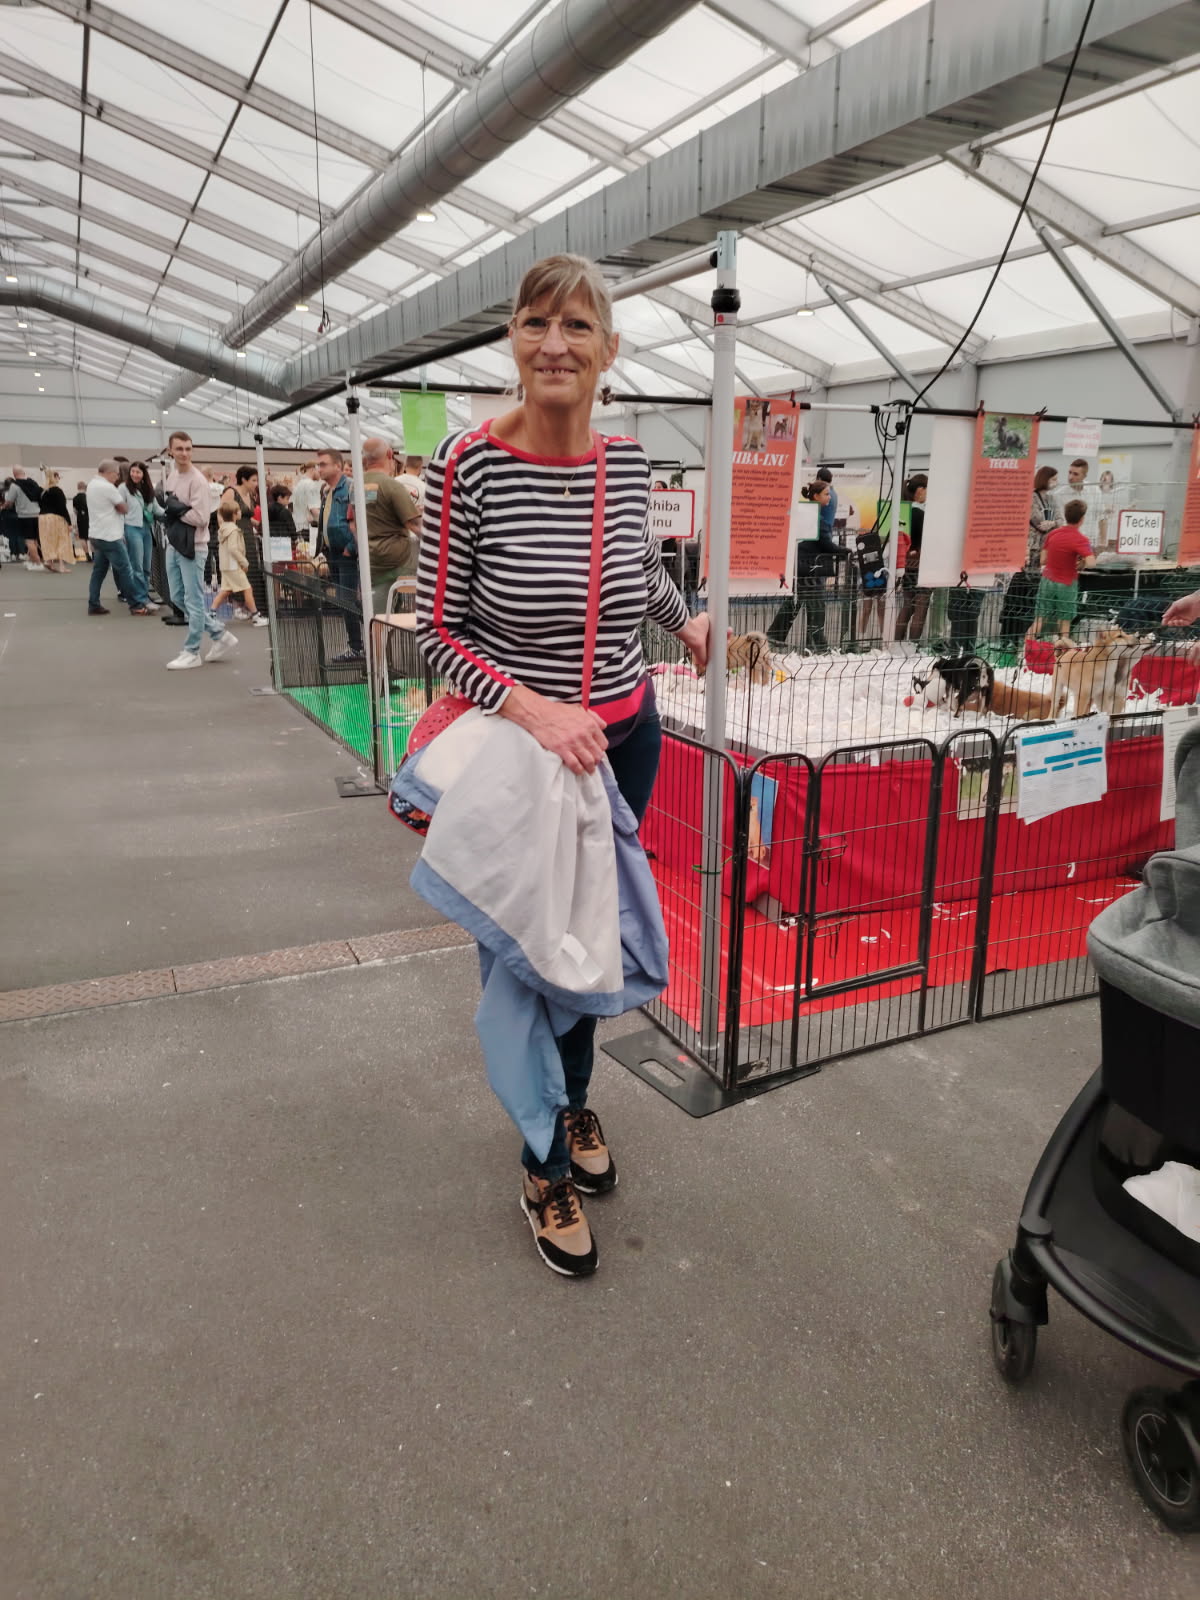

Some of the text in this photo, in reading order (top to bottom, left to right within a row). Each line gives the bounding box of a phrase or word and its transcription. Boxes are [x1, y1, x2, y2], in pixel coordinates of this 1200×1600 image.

[989, 458, 1019, 469] TECKEL
[653, 516, 672, 528] inu
[1125, 515, 1160, 528] Teckel
[1120, 534, 1160, 548] poil ras
